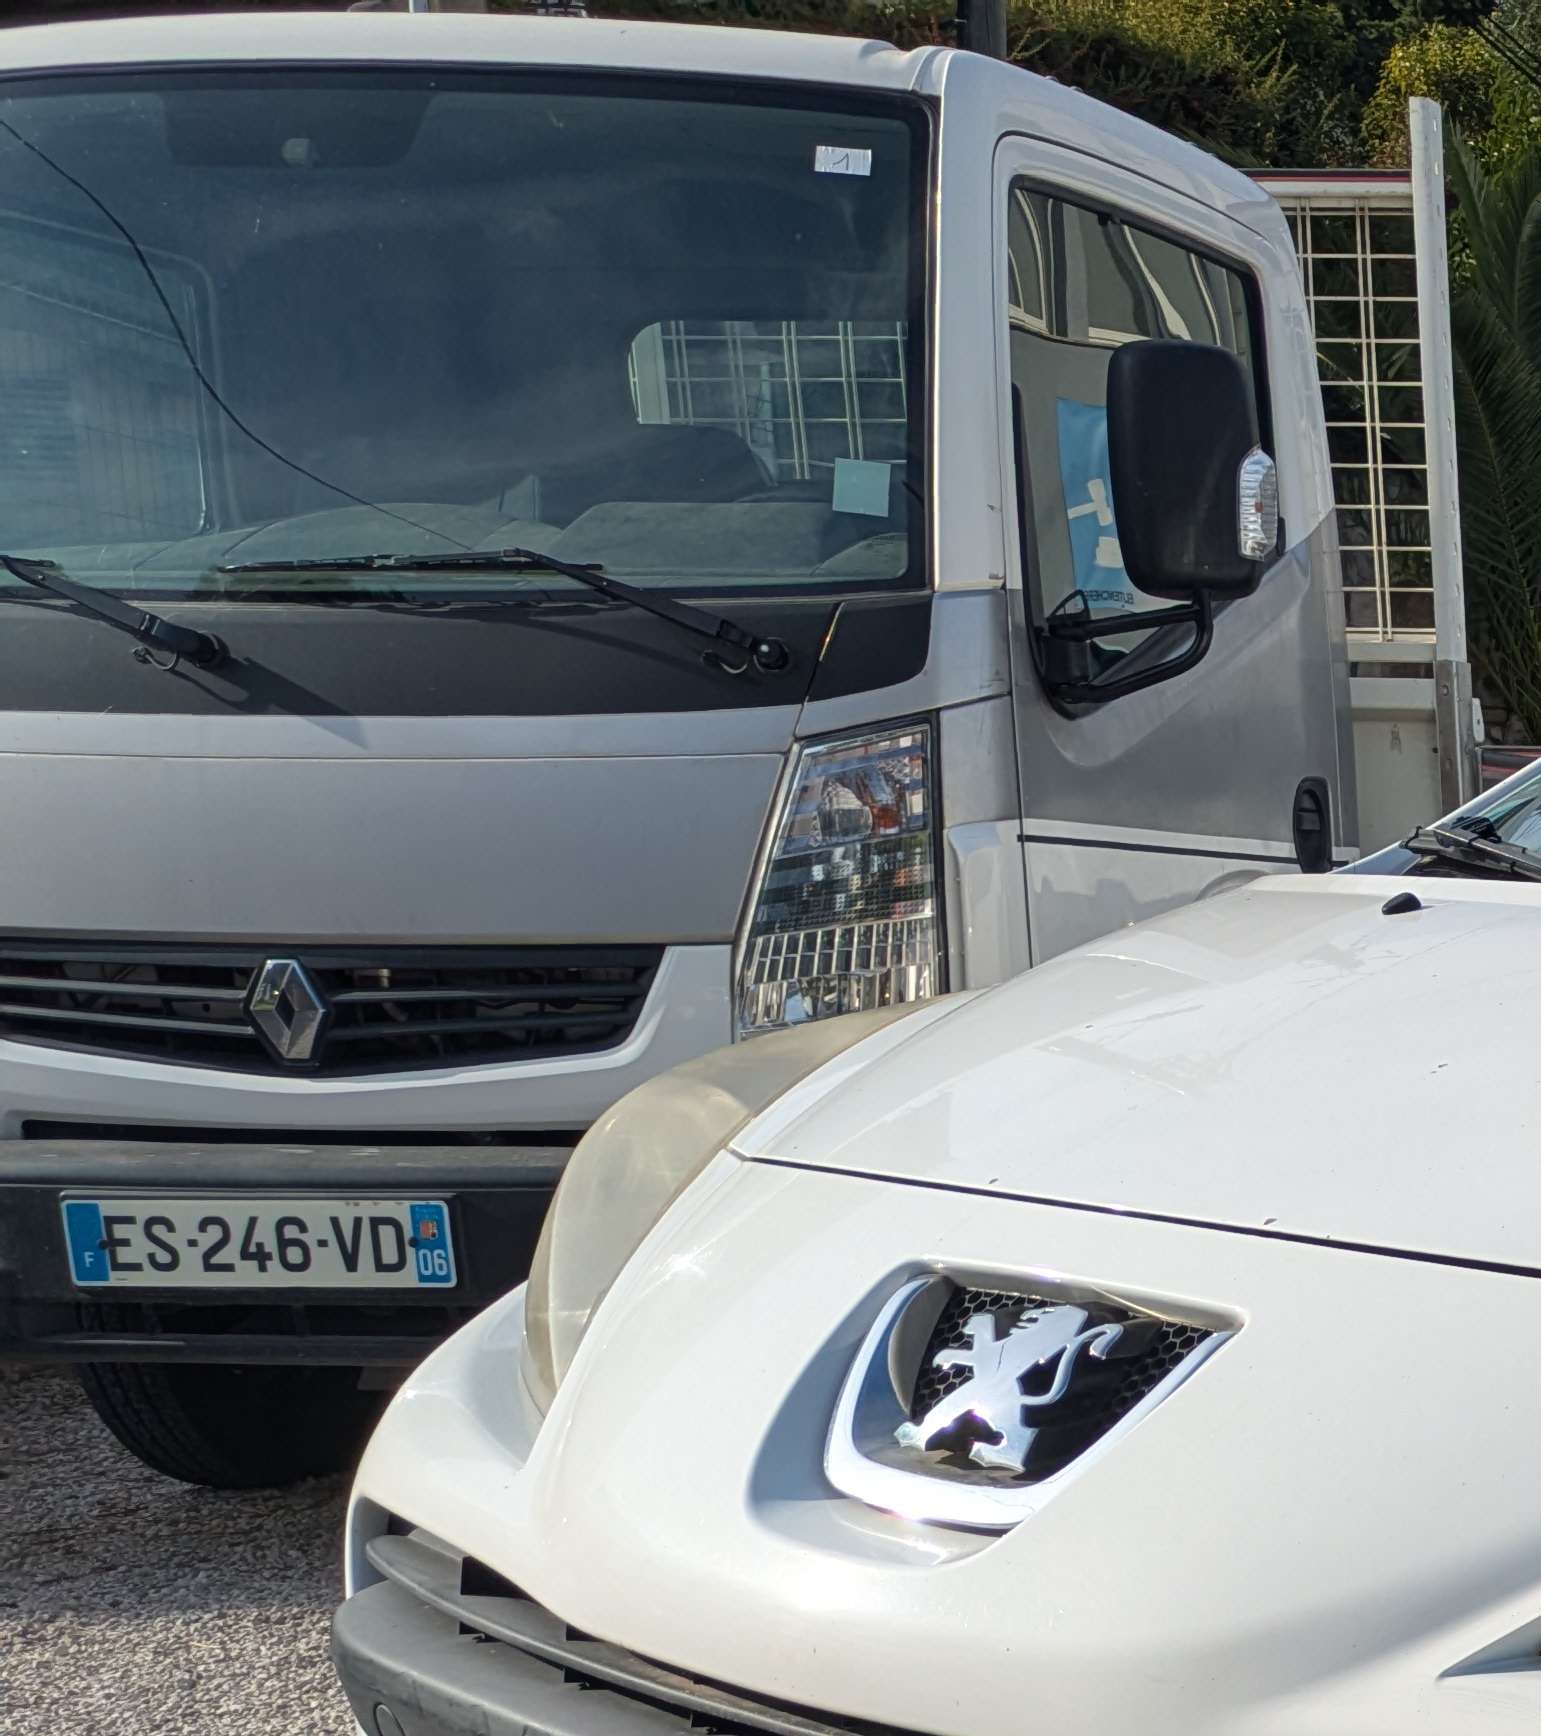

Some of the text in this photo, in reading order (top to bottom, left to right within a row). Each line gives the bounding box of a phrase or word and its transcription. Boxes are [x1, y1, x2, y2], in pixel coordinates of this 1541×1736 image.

[103, 1215, 408, 1273] ES-246-VD
[83, 1251, 95, 1269] F
[418, 1248, 449, 1276] 06
